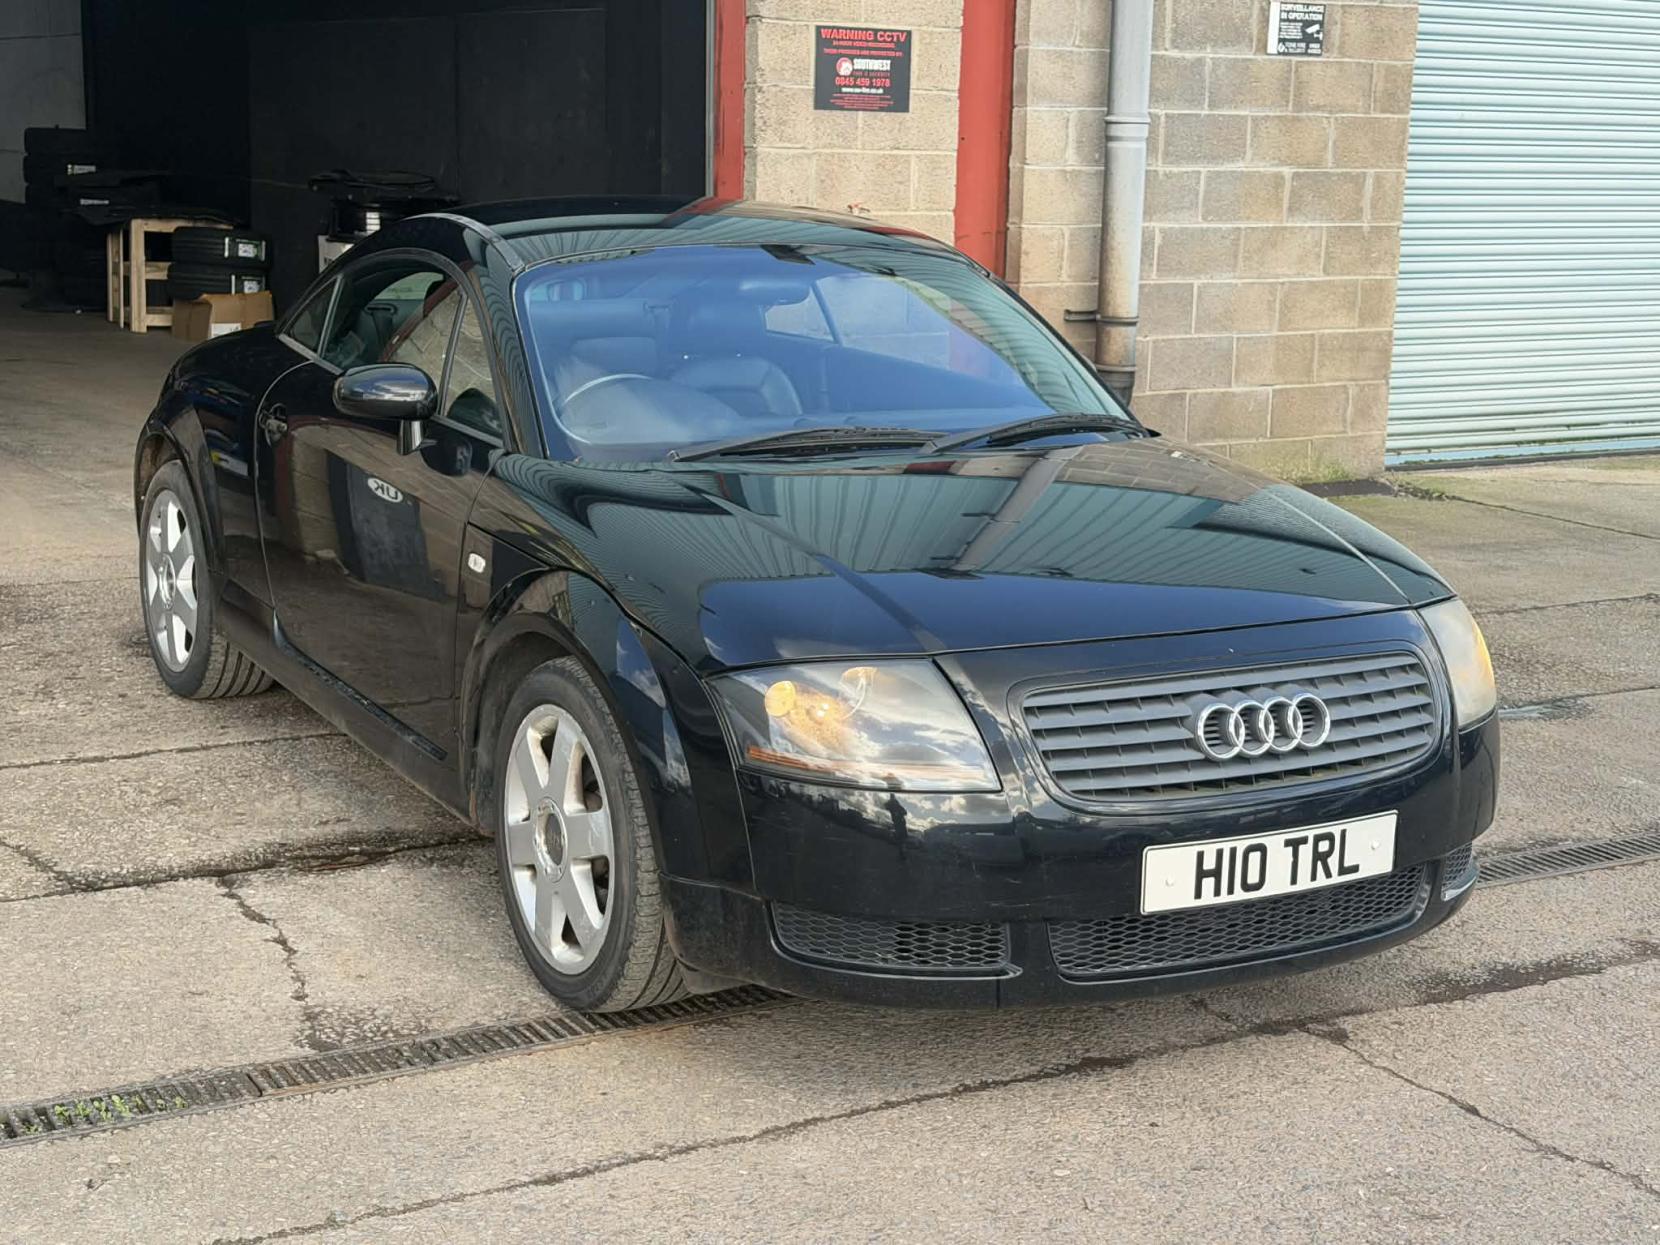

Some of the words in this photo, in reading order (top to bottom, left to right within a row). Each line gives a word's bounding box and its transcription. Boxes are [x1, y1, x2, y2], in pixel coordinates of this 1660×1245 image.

[820, 28, 874, 40] WARNING
[877, 31, 907, 42] CCTV
[835, 77, 855, 86] 0845
[856, 77, 870, 87] 459
[872, 78, 891, 88] 1978
[1194, 842, 1268, 900] H10
[1283, 828, 1360, 886] TRL
